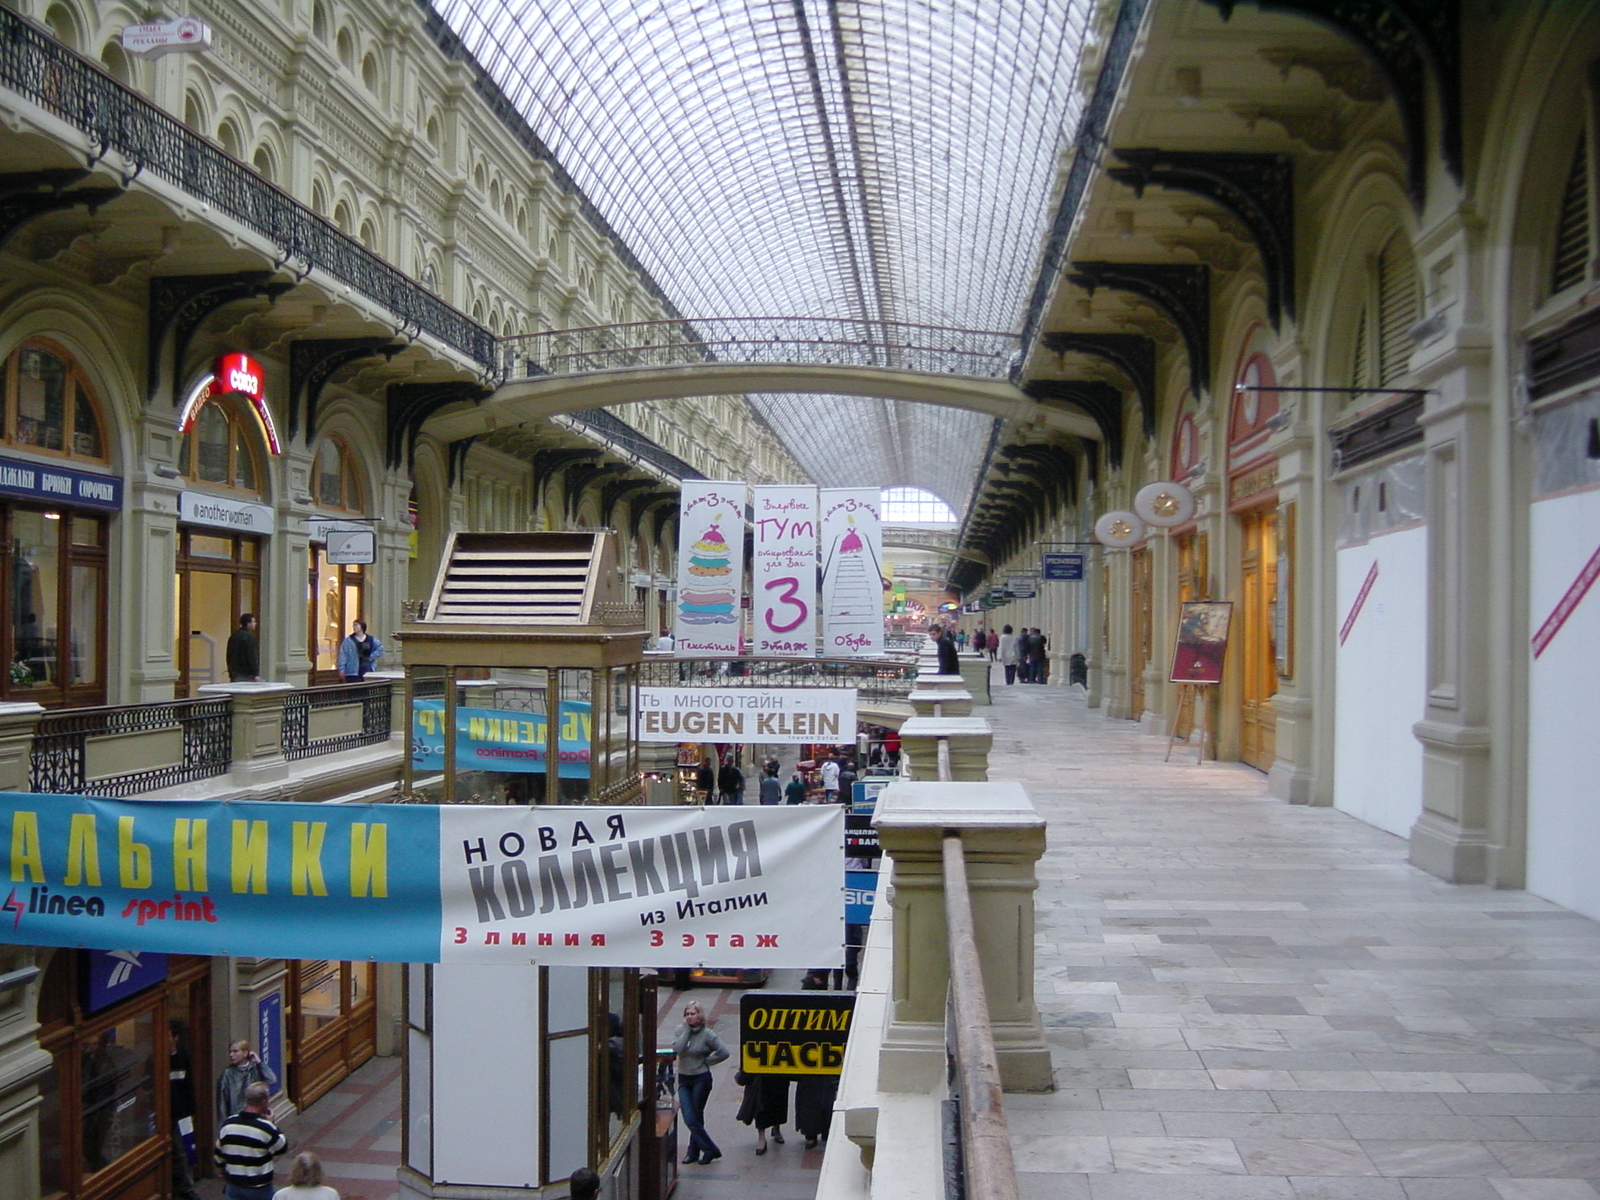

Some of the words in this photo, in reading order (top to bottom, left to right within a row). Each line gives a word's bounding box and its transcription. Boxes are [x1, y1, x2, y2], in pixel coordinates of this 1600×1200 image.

[230, 369, 258, 395] СОЮЗ
[190, 387, 210, 420] ВИДЕО
[42, 473, 72, 495] БРЮКИ
[79, 480, 114, 501] СОРОЧКИ
[707, 493, 720, 507] 3
[845, 498, 858, 512] 3
[765, 577, 808, 632] 3
[677, 638, 736, 652] Текстиль
[760, 640, 808, 651] этаж
[834, 633, 872, 652] Обувь
[674, 694, 733, 708] много
[739, 692, 783, 709] тайн
[646, 711, 744, 734] EUGEN
[757, 713, 839, 735] KLEIN
[463, 813, 626, 865] НОВАЯ
[10, 811, 388, 898] АЛЬНИКИ
[467, 819, 763, 924] КОЛЛЕКЦИЯ
[29, 886, 105, 917] linea
[122, 893, 218, 926] sprint
[640, 908, 666, 926] из
[676, 891, 769, 920] Италии
[454, 927, 468, 944] 3
[484, 932, 606, 947] линия
[650, 929, 664, 947] 3
[682, 933, 780, 948] этаж
[748, 1008, 852, 1030] ОПТИМ
